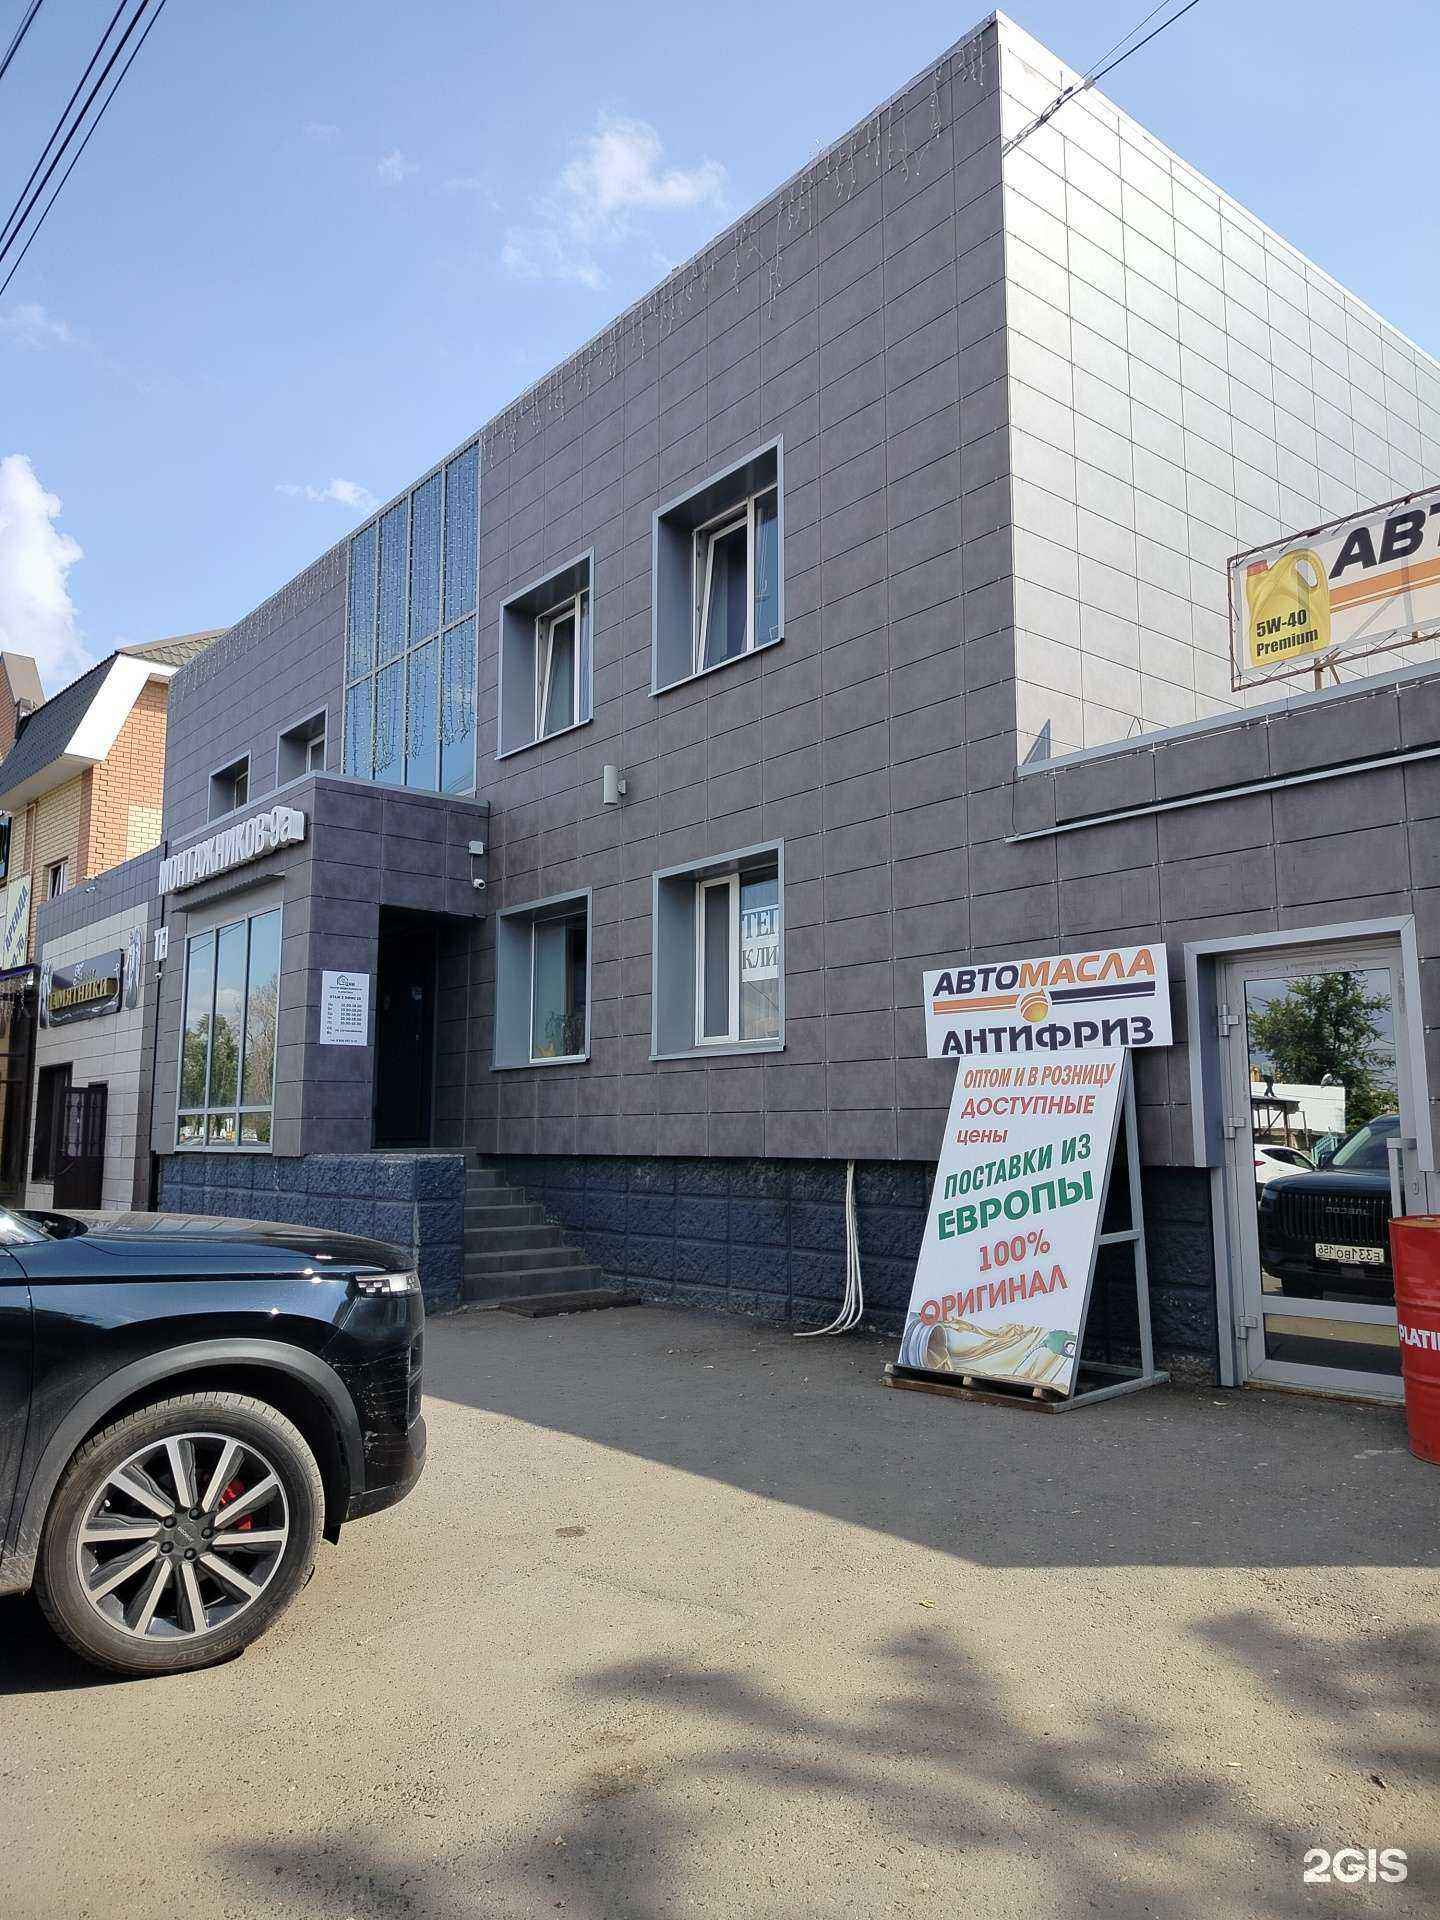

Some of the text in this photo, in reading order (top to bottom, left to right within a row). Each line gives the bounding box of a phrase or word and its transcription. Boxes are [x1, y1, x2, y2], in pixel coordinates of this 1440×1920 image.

[1328, 502, 1440, 580] АВ
[1255, 608, 1308, 638] 5W-40
[1255, 628, 1319, 657] Premium
[932, 948, 1156, 997] АВТОМАСЛА
[941, 1016, 1155, 1056] АНТИФРИЗ
[963, 1063, 1116, 1089] ОПТОМ И В РОЗНИЦУ
[960, 1095, 1096, 1120] ДОСТУПНЫЕ
[956, 1129, 1009, 1146] цены
[944, 1133, 1092, 1200] ПОСТАВКИ ИЗ
[937, 1170, 1094, 1241] ЕВРОПЫ
[978, 1228, 1051, 1273] 100%
[919, 1264, 1069, 1327] ОРИГИНАЛ
